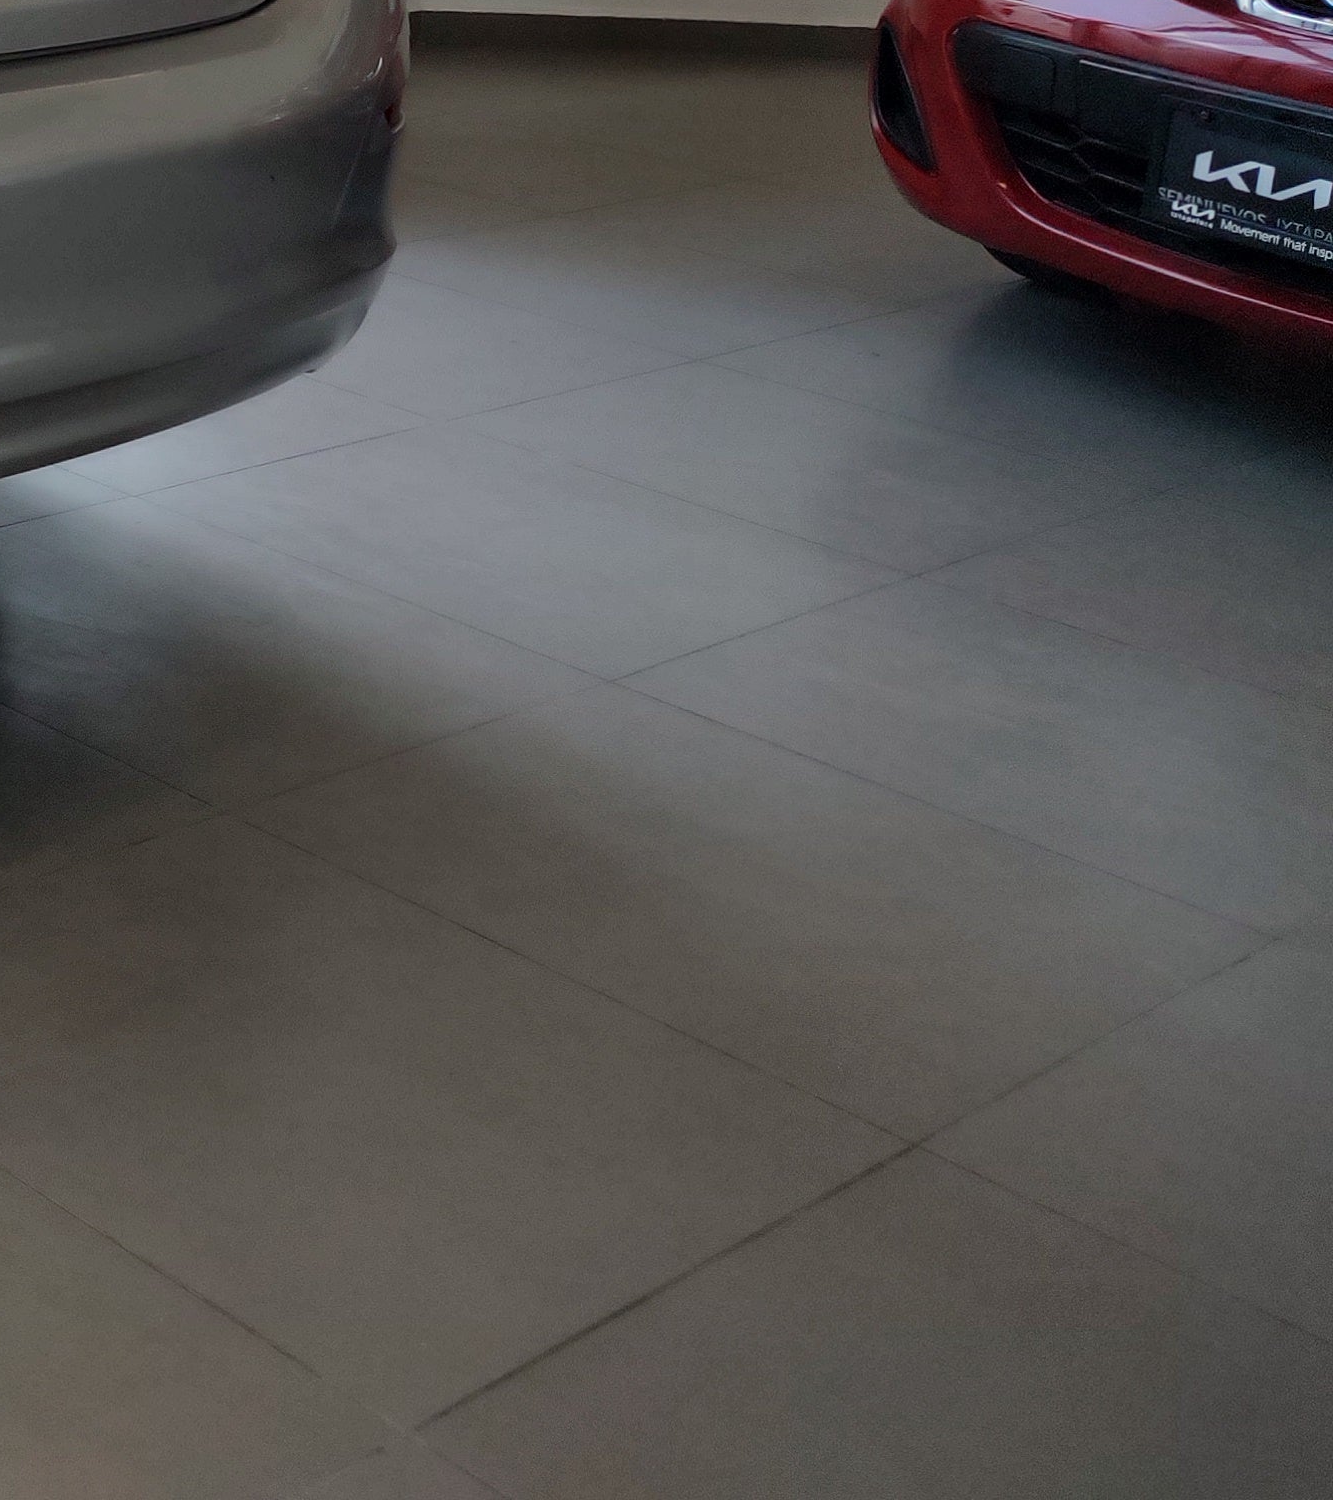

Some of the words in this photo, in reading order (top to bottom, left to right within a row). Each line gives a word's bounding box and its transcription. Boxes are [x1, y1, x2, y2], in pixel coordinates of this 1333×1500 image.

[1193, 150, 1333, 210] KIA
[1220, 217, 1280, 246] Movement
[1283, 237, 1307, 252] that
